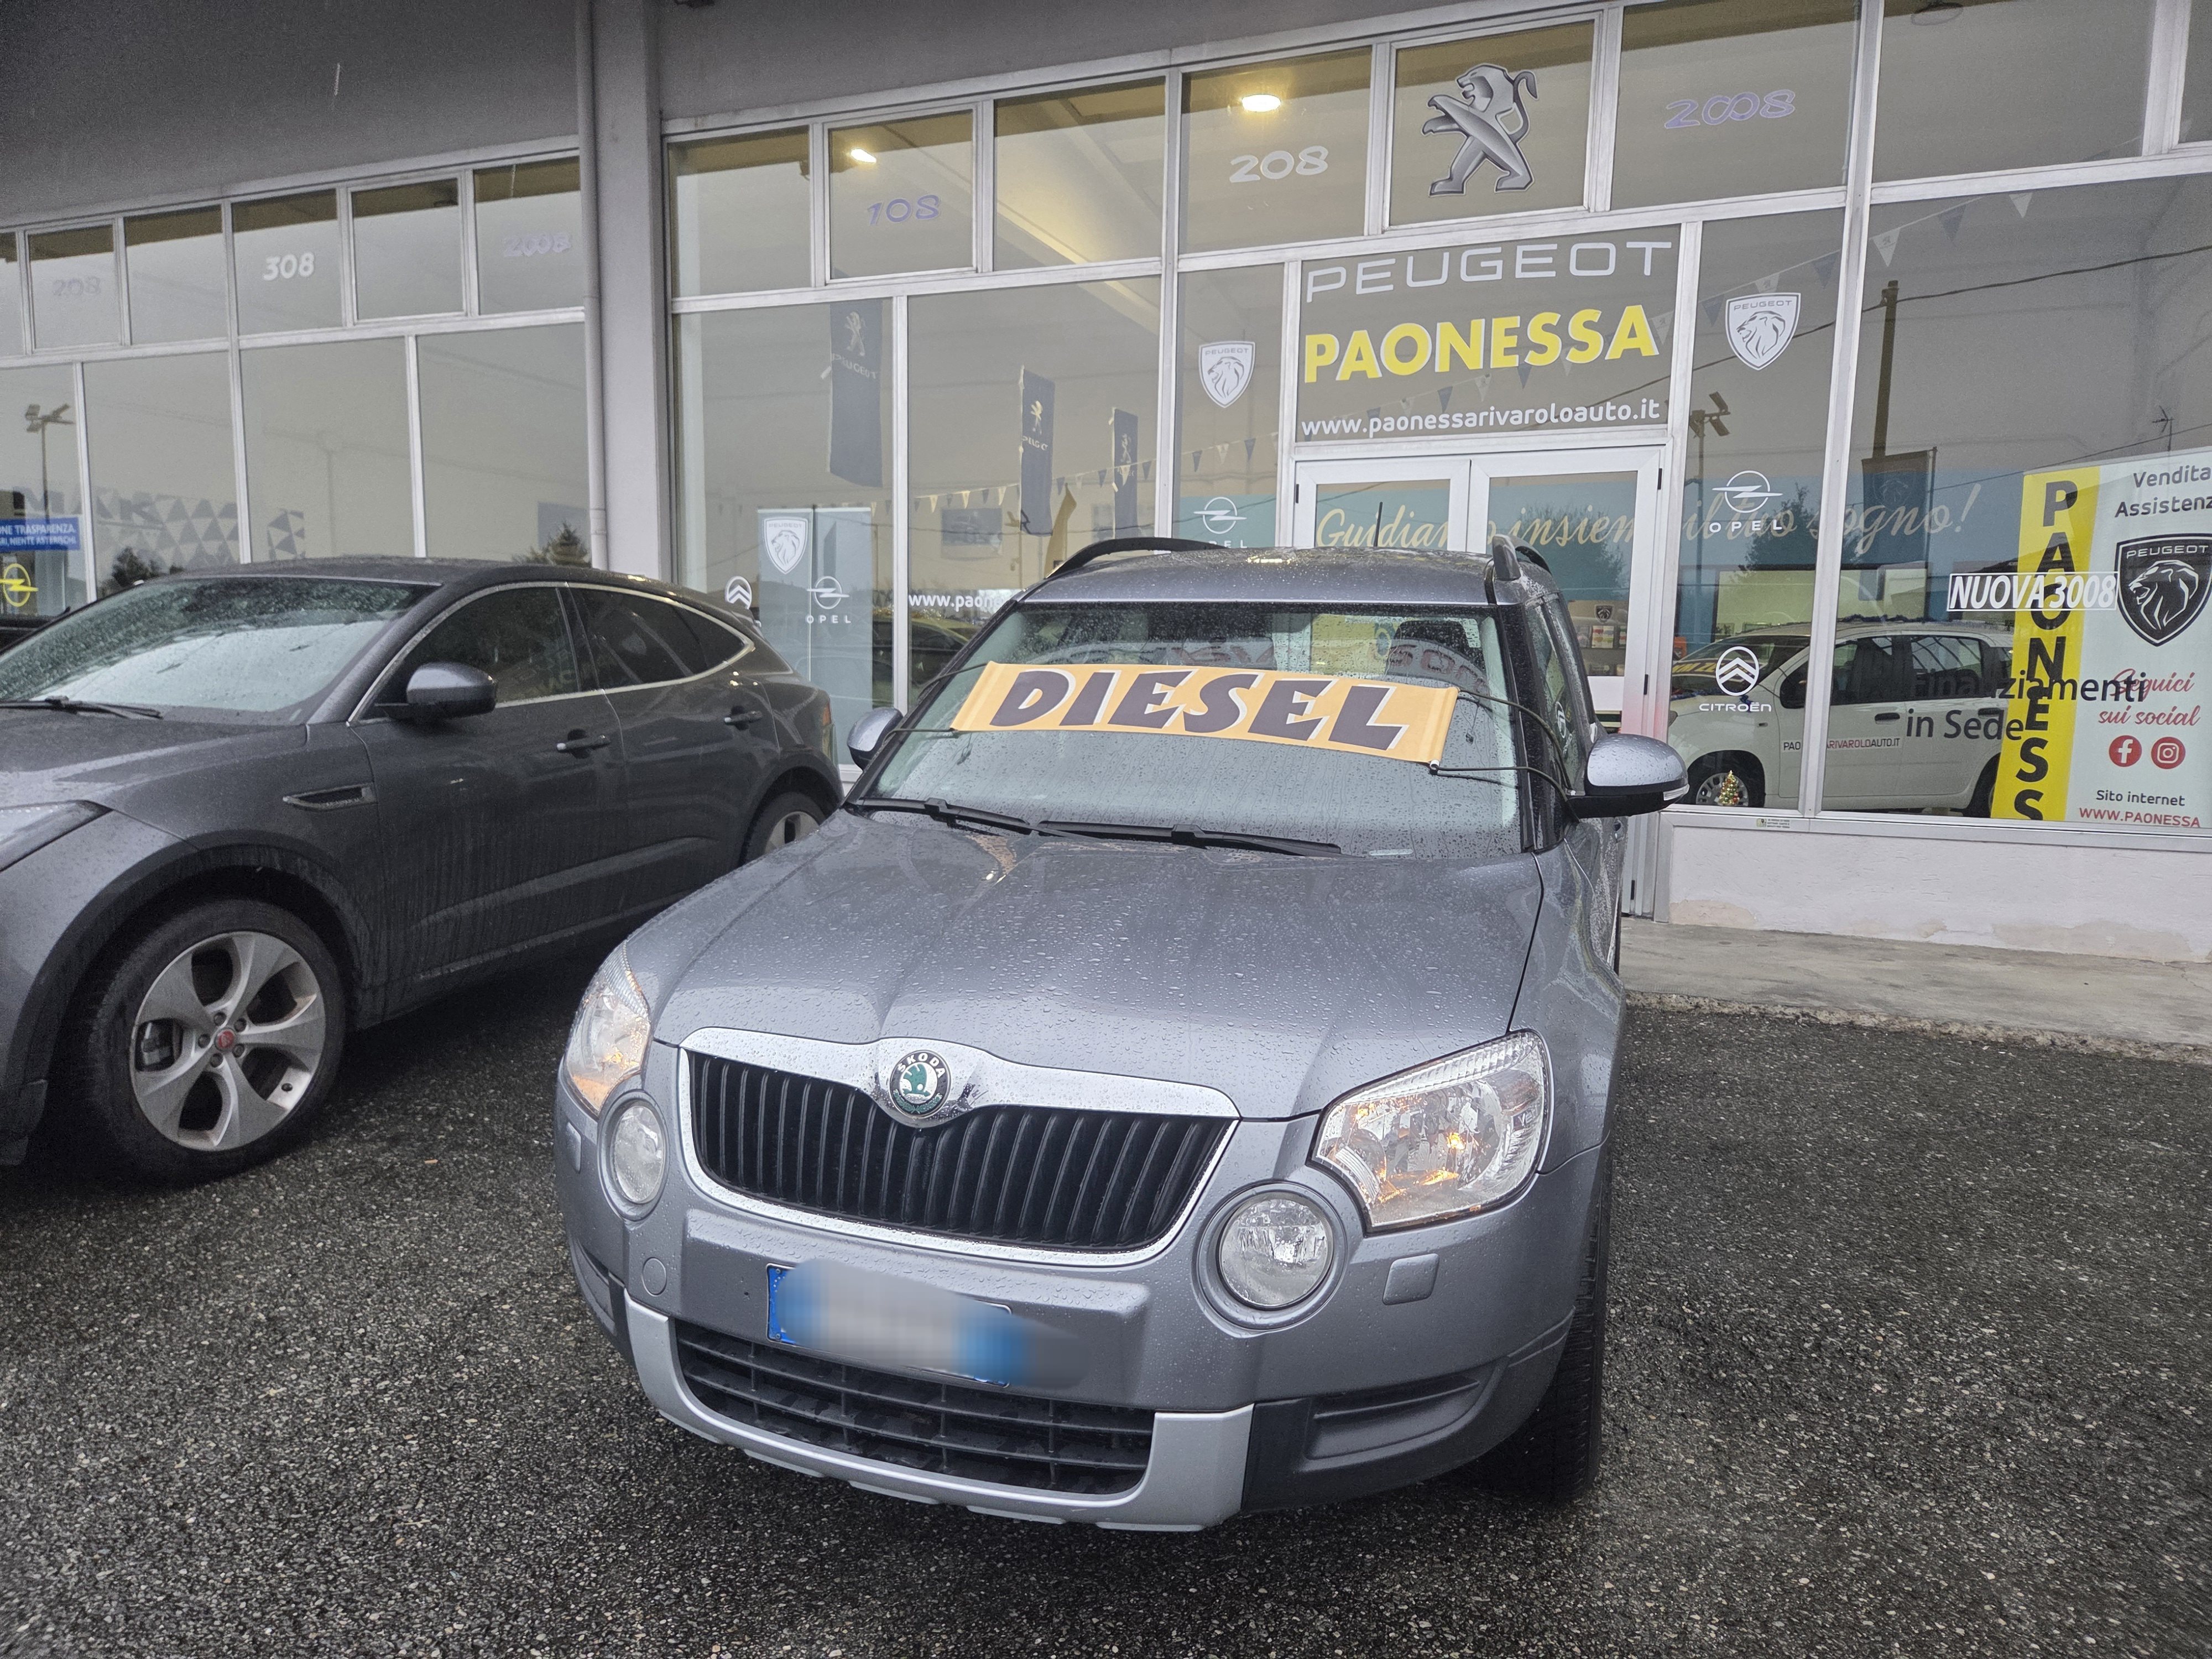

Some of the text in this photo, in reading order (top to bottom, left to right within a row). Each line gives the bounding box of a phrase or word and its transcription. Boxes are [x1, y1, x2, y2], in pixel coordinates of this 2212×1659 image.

[1664, 89, 1796, 129] 2008
[1229, 145, 1329, 182] 208
[867, 194, 941, 226] 108
[263, 252, 316, 281] 308
[1306, 241, 1672, 303] PEUGEOT
[1733, 299, 1793, 311] PEUGEOT
[1204, 347, 1249, 356] PEUGEOT
[1304, 304, 1660, 383] PAONESSA
[1301, 398, 1660, 439] www.paonessarivaroloauto.it
[2133, 465, 2211, 488] Vendita
[1709, 518, 1783, 533] OPEL
[2126, 545, 2209, 559] PEUGEOT
[2048, 575, 2117, 609] 3008
[806, 614, 852, 624] OPEL
[989, 668, 1410, 751] DIESEL
[2098, 705, 2201, 726] sui social
[1906, 708, 2025, 741] in Sede
[2096, 790, 2185, 806] Sito internet
[2079, 807, 2201, 828] WWW.PAONESSA
